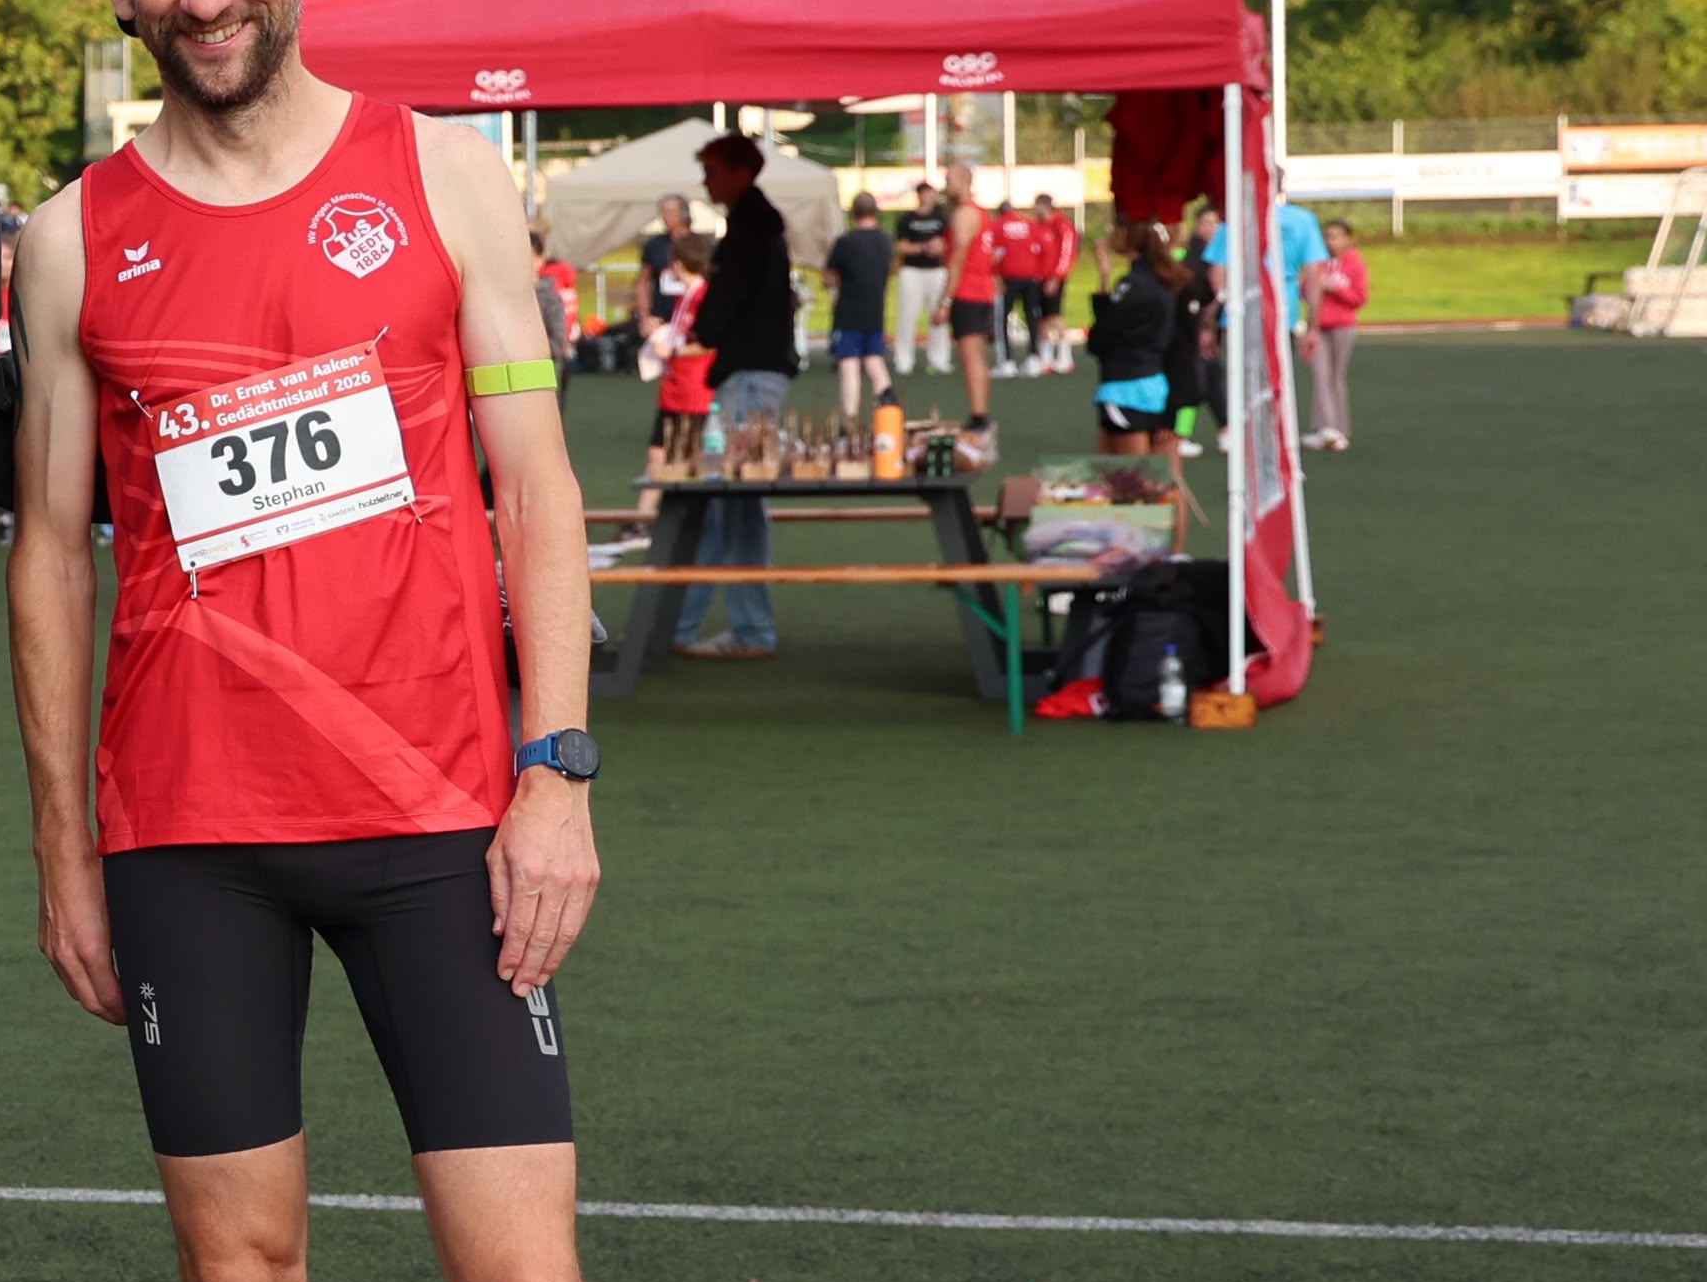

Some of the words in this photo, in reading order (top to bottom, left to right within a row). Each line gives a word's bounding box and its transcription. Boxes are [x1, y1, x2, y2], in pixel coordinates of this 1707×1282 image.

[330, 192, 376, 205] Menschen
[349, 231, 384, 260] OEDT
[356, 244, 390, 271] 1884
[117, 258, 162, 283] erima
[210, 391, 232, 409] Dr.
[235, 380, 277, 402] Ernst
[279, 371, 308, 387] van
[312, 354, 366, 379] Aaken-
[216, 381, 331, 427] Gedächtnislauf
[334, 371, 372, 392] 2026
[158, 403, 211, 440] 43.
[210, 410, 342, 497] 376
[252, 480, 326, 511] Stephan
